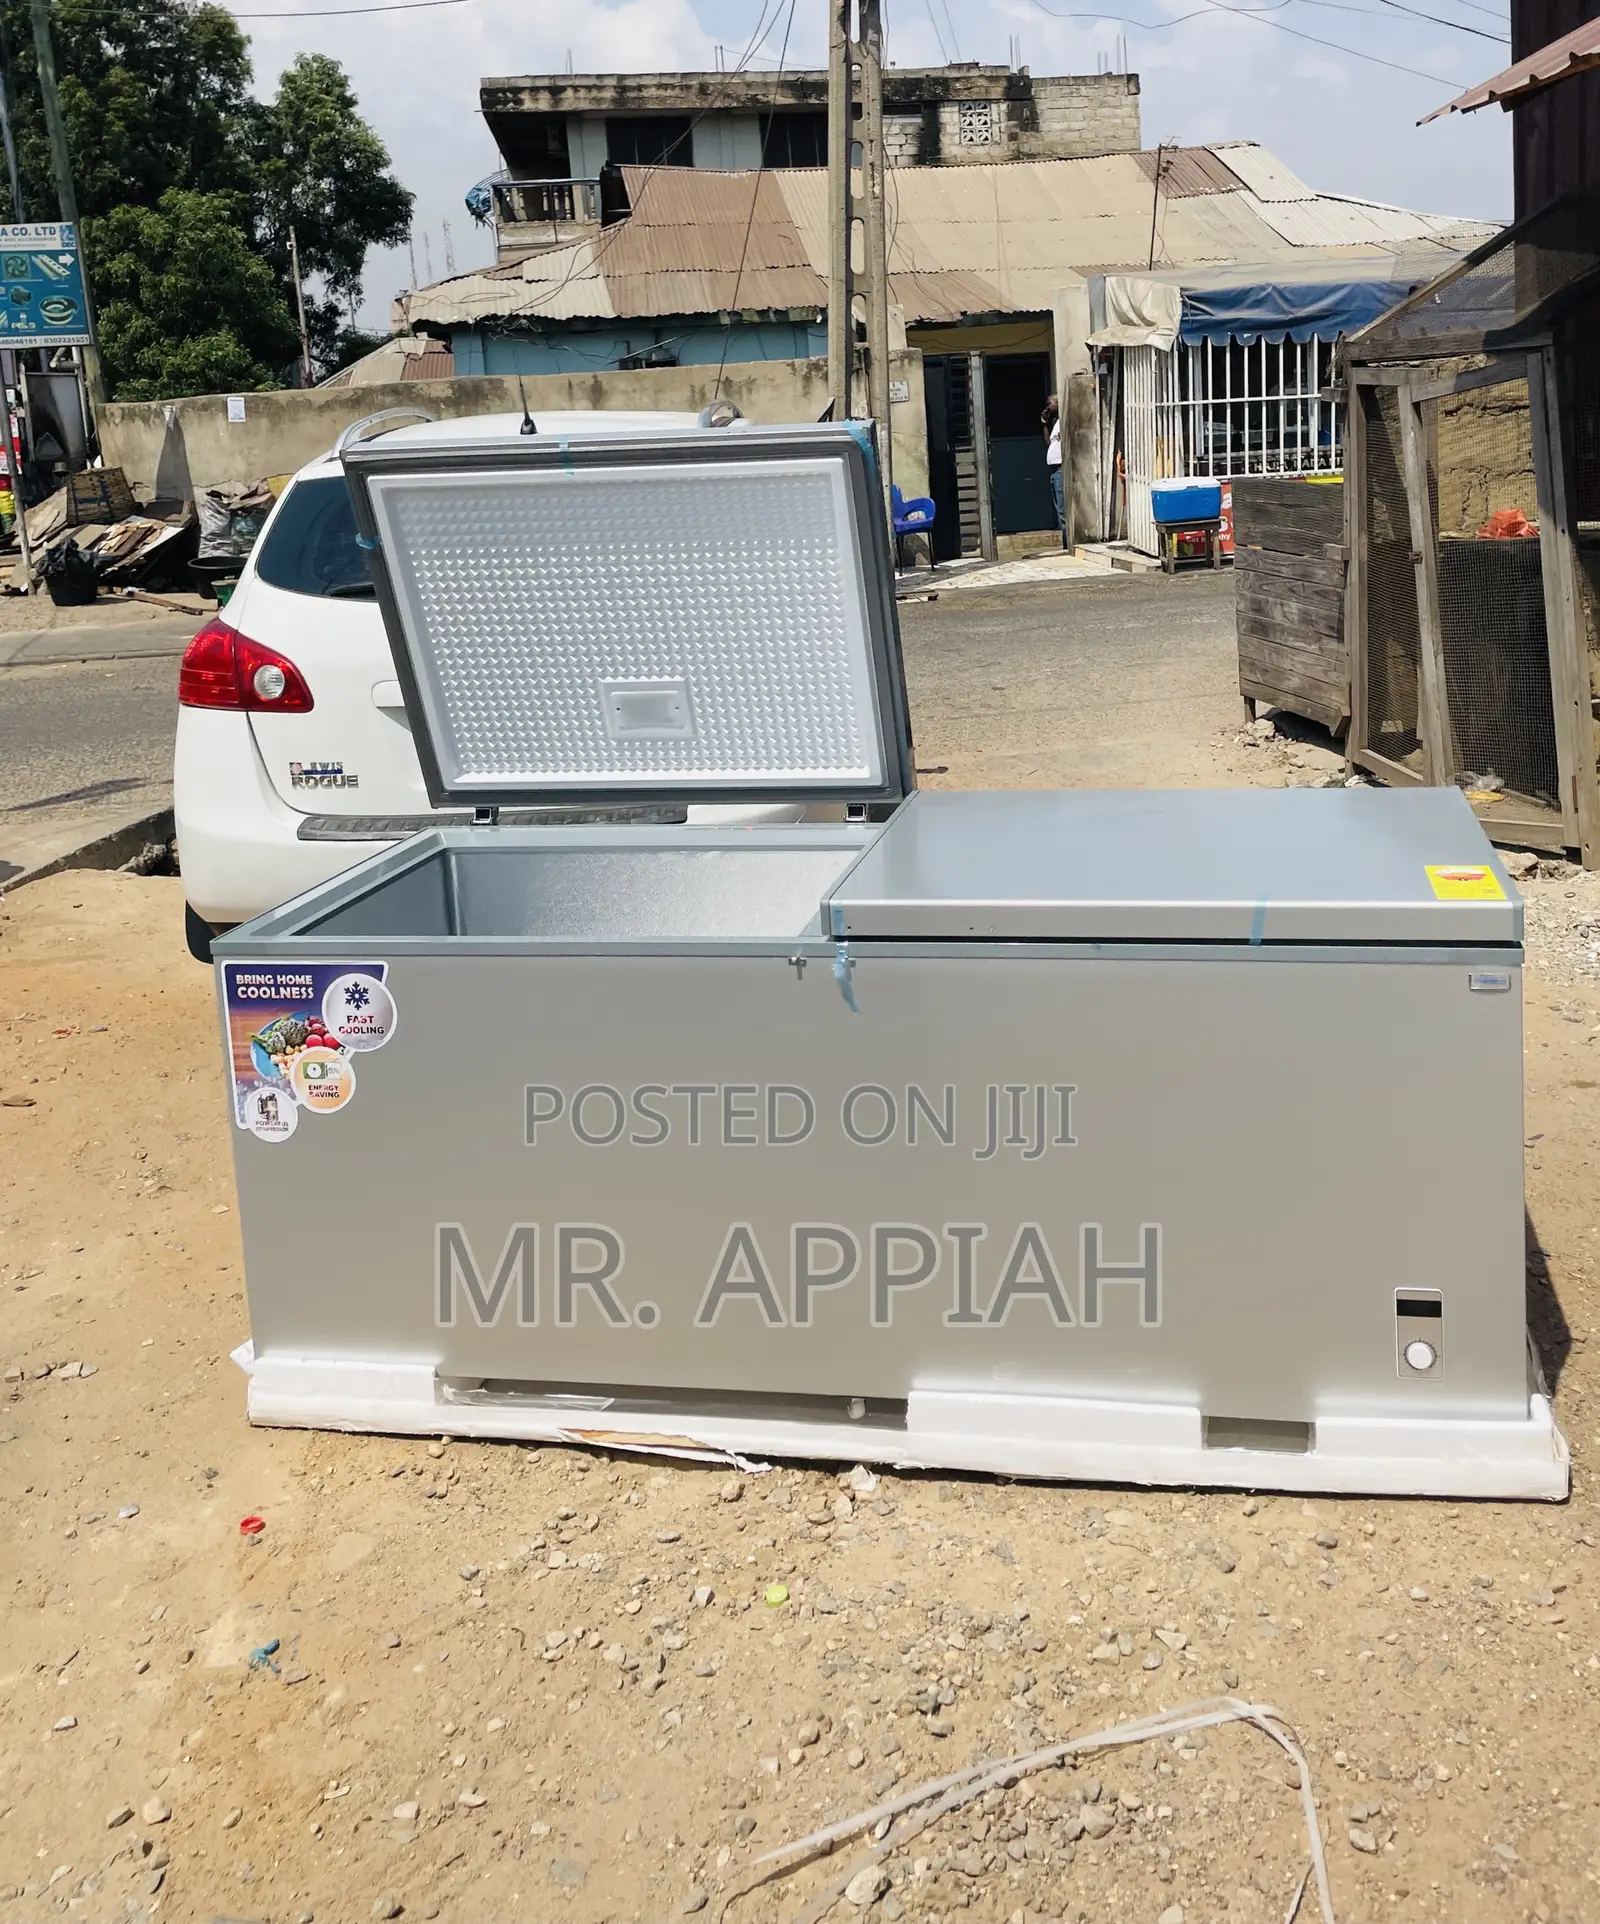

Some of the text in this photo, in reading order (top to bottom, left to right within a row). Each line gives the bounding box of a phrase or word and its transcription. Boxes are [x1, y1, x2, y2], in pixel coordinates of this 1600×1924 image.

[12, 227, 32, 237] CO.
[35, 226, 57, 236] LTD
[291, 775, 359, 790] ROGUE
[236, 974, 313, 985] BRING HOME
[237, 986, 314, 999] COOLNESS
[347, 1015, 375, 1024] FAST
[338, 1026, 385, 1035] COOLING
